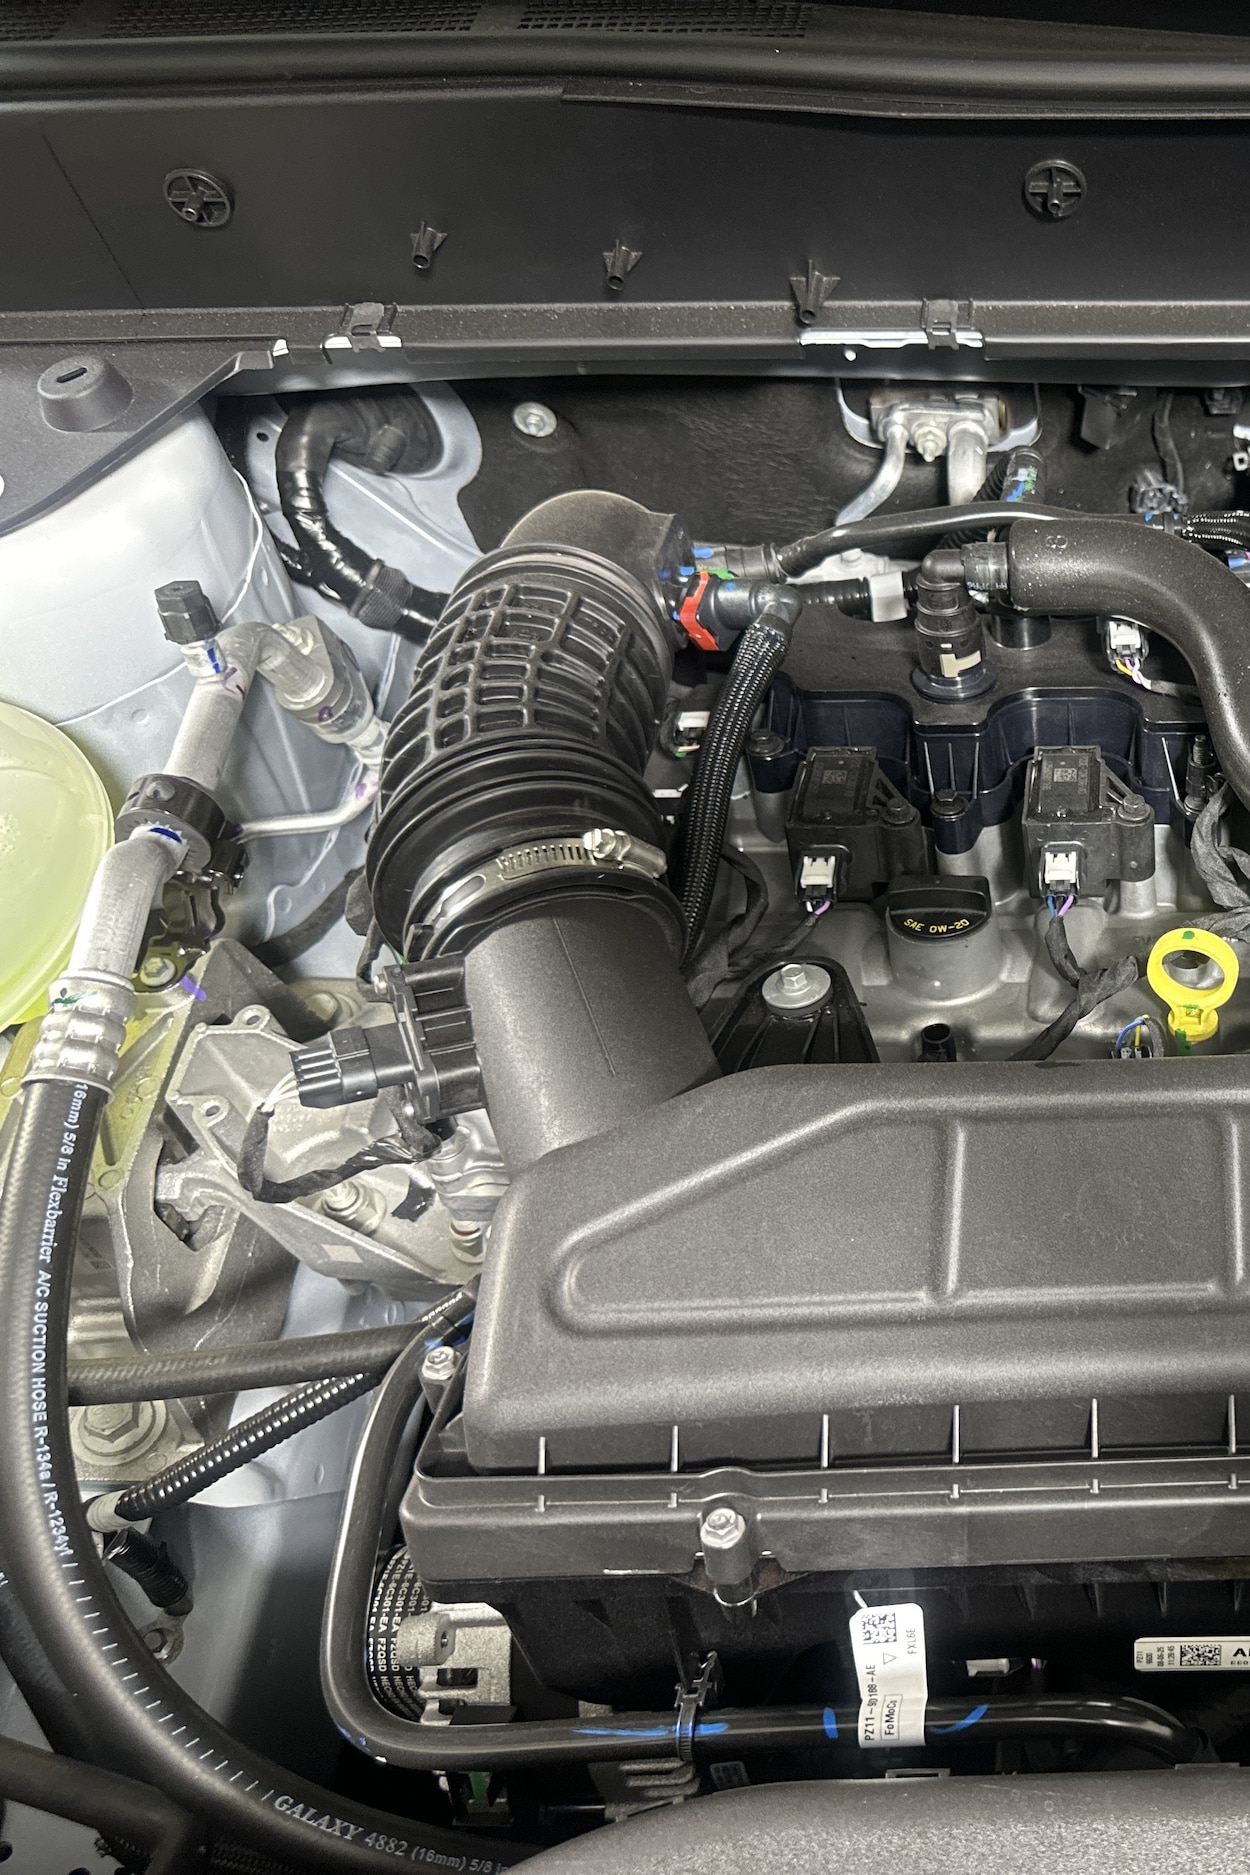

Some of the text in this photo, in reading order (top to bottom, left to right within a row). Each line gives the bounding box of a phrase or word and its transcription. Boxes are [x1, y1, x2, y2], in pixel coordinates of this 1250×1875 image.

[904, 918, 970, 934] SAE 0W-20
[61, 1131, 77, 1155] 5/8
[56, 1157, 72, 1171] in
[38, 1174, 69, 1263] Flexbarrier
[36, 1269, 52, 1298] A/C
[32, 1302, 48, 1373] SUCTION
[31, 1377, 47, 1421] HOSE
[33, 1426, 53, 1481] R-134a
[44, 1490, 75, 1557] R-1234yf
[906, 1628, 918, 1655] FXL6E
[884, 1699, 898, 1736] FoMoCo
[274, 1795, 365, 1841] GALAXY
[365, 1832, 408, 1857] 4882
[410, 1845, 467, 1872] (16mm)
[469, 1857, 493, 1873] 5/8
